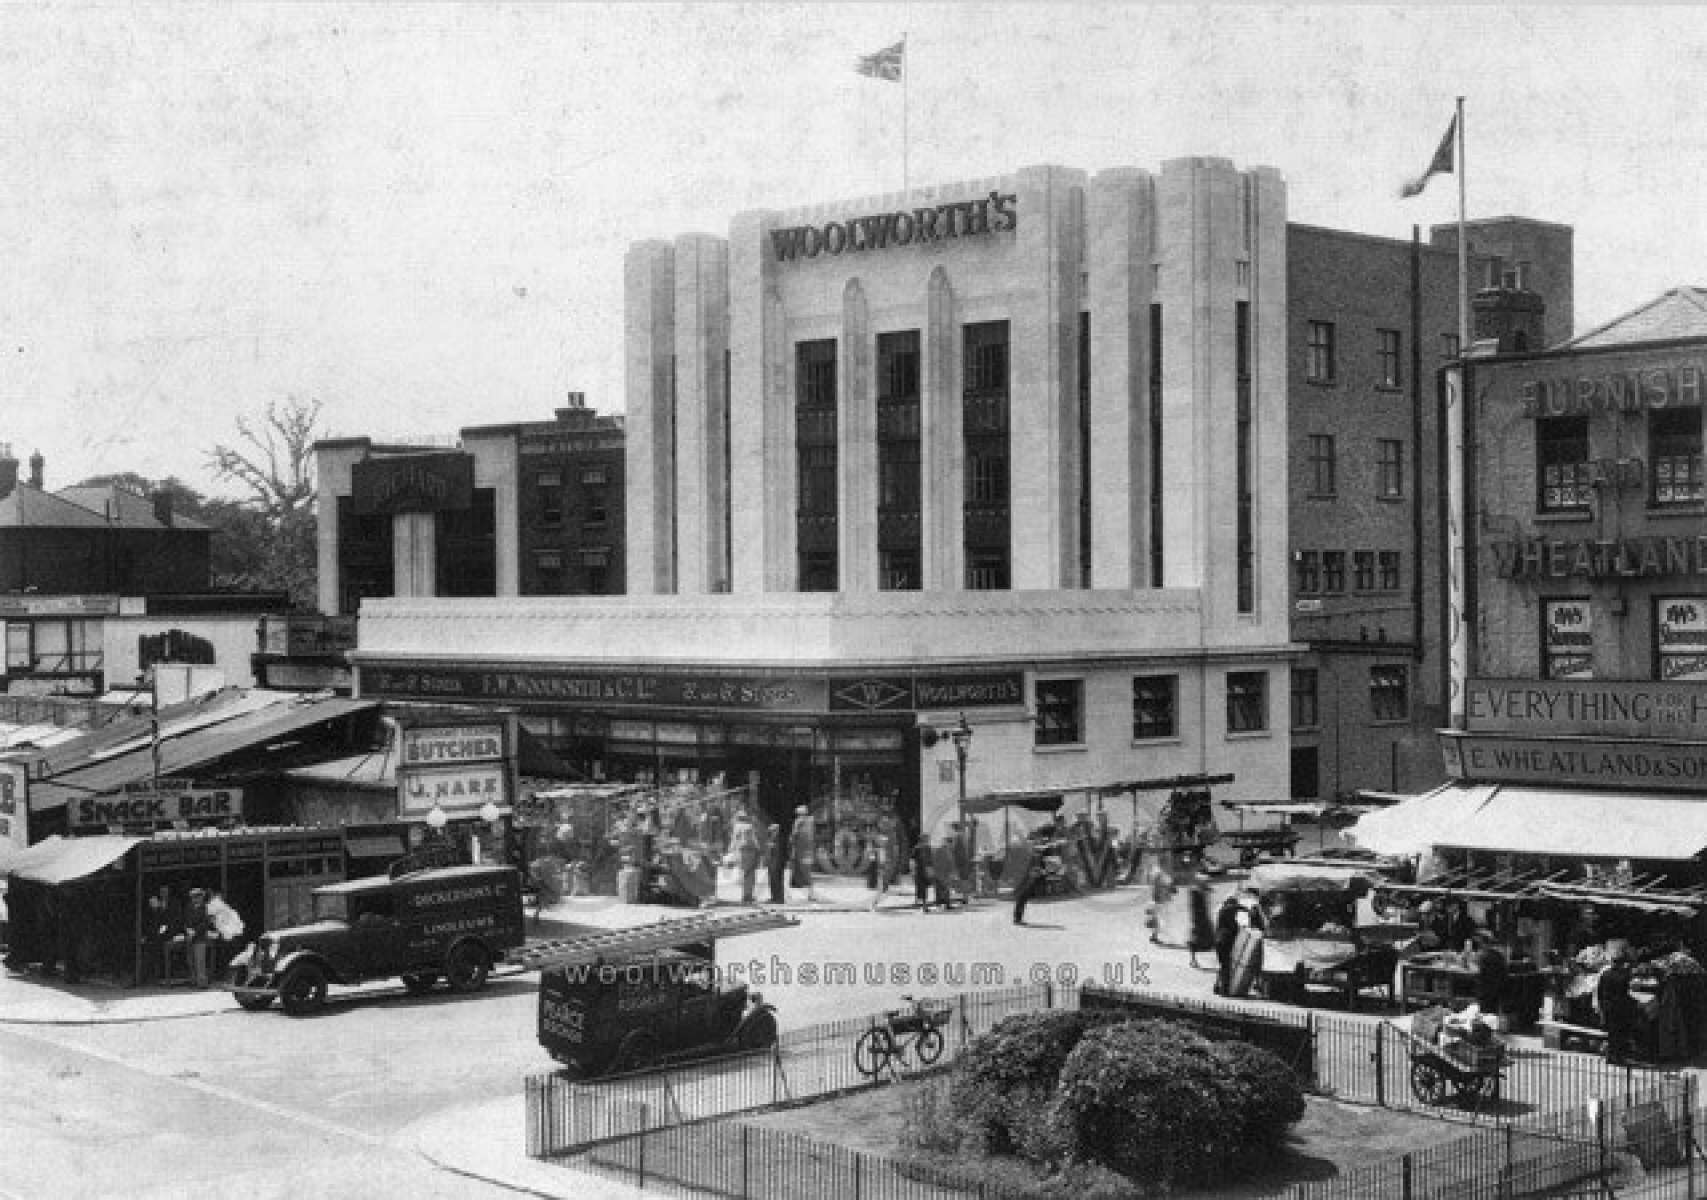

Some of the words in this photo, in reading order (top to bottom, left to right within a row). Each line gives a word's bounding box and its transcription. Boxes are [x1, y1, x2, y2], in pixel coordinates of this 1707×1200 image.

[768, 190, 1017, 262] WOOLWORTH'S
[1468, 687, 1651, 723] EVERYTHING
[1657, 710, 1685, 724] THE
[407, 738, 499, 761] BUTCHER
[79, 797, 165, 825] SNACK
[178, 791, 231, 818] BAR
